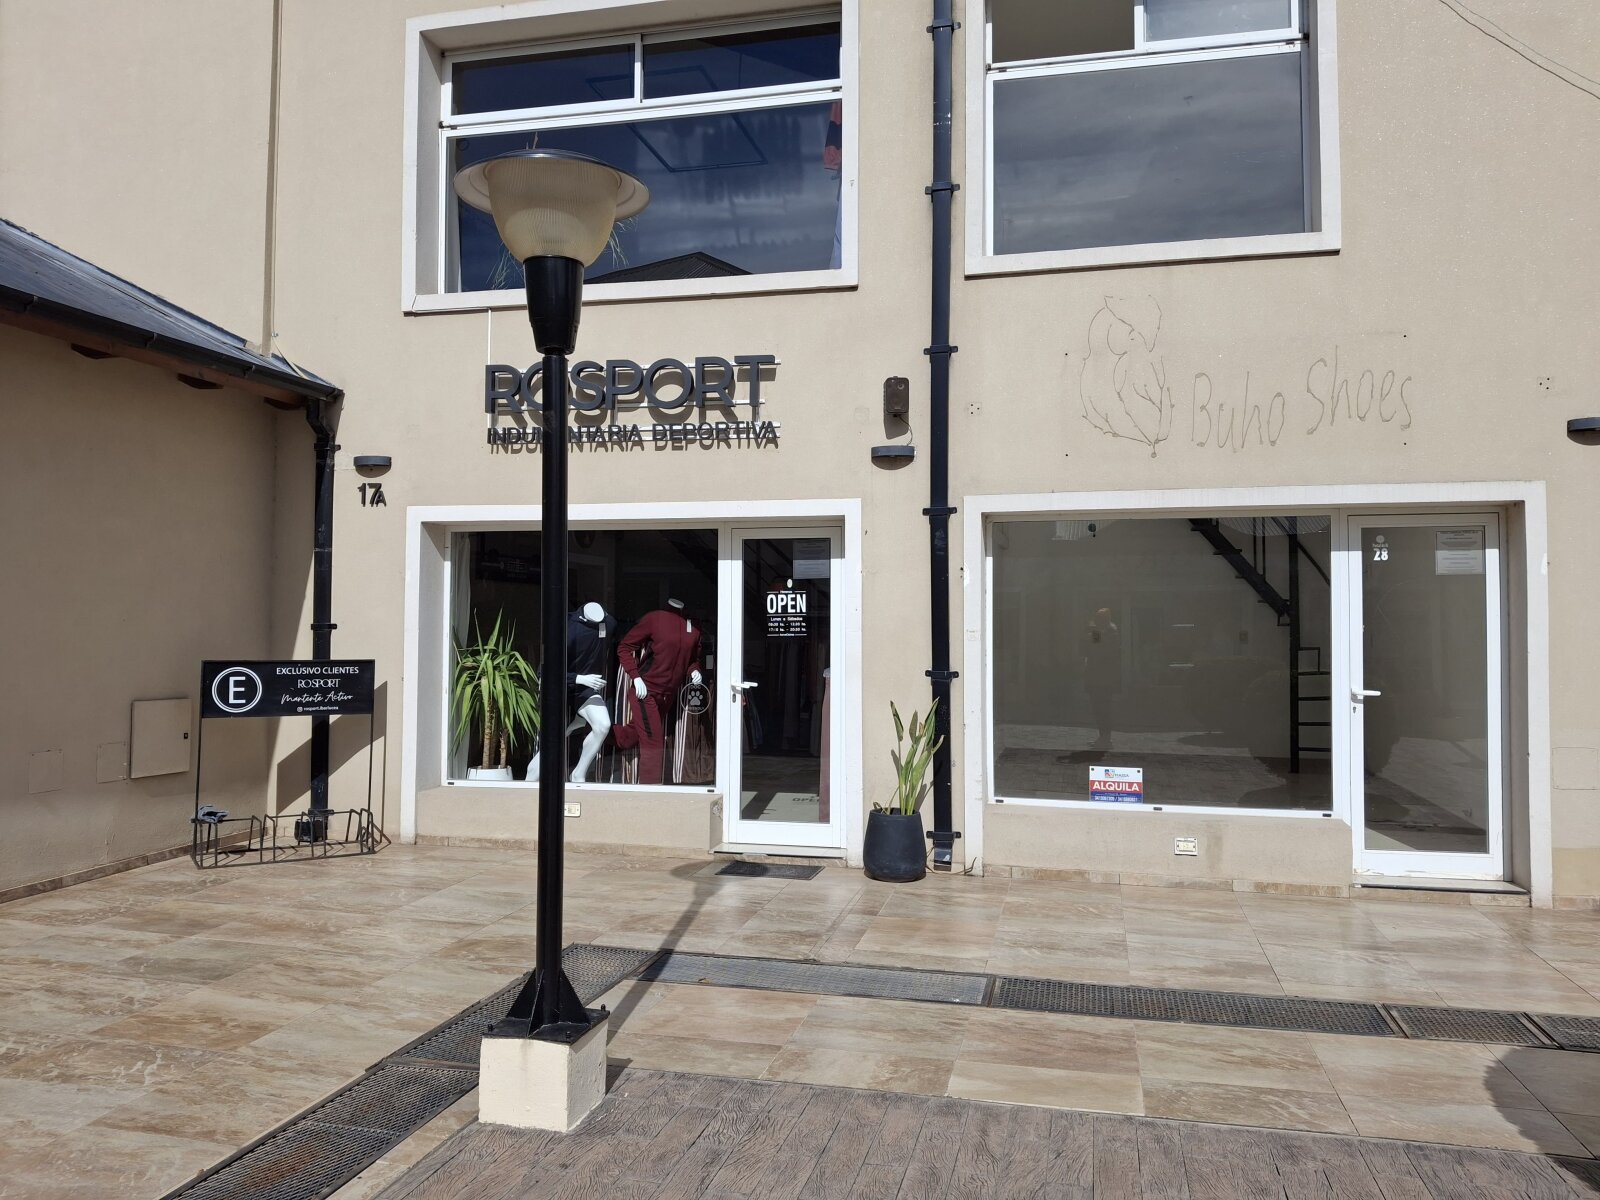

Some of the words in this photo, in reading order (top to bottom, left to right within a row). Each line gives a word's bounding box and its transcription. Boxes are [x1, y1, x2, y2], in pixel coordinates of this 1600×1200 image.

[1191, 371, 1285, 453] Buho
[1306, 345, 1412, 435] Shoes
[487, 424, 643, 444] INDUNTARIA
[652, 421, 778, 441] DEPORTIVA
[357, 483, 387, 508] 17A
[1373, 548, 1388, 561] 28
[766, 594, 806, 613] OPEN
[276, 667, 321, 675] EXCLUSIVO
[322, 666, 360, 674] CLIENTES
[229, 676, 246, 704] E
[297, 678, 341, 688] ROSPORT
[324, 690, 353, 702] Activo
[1092, 781, 1140, 791] ALQUILA
